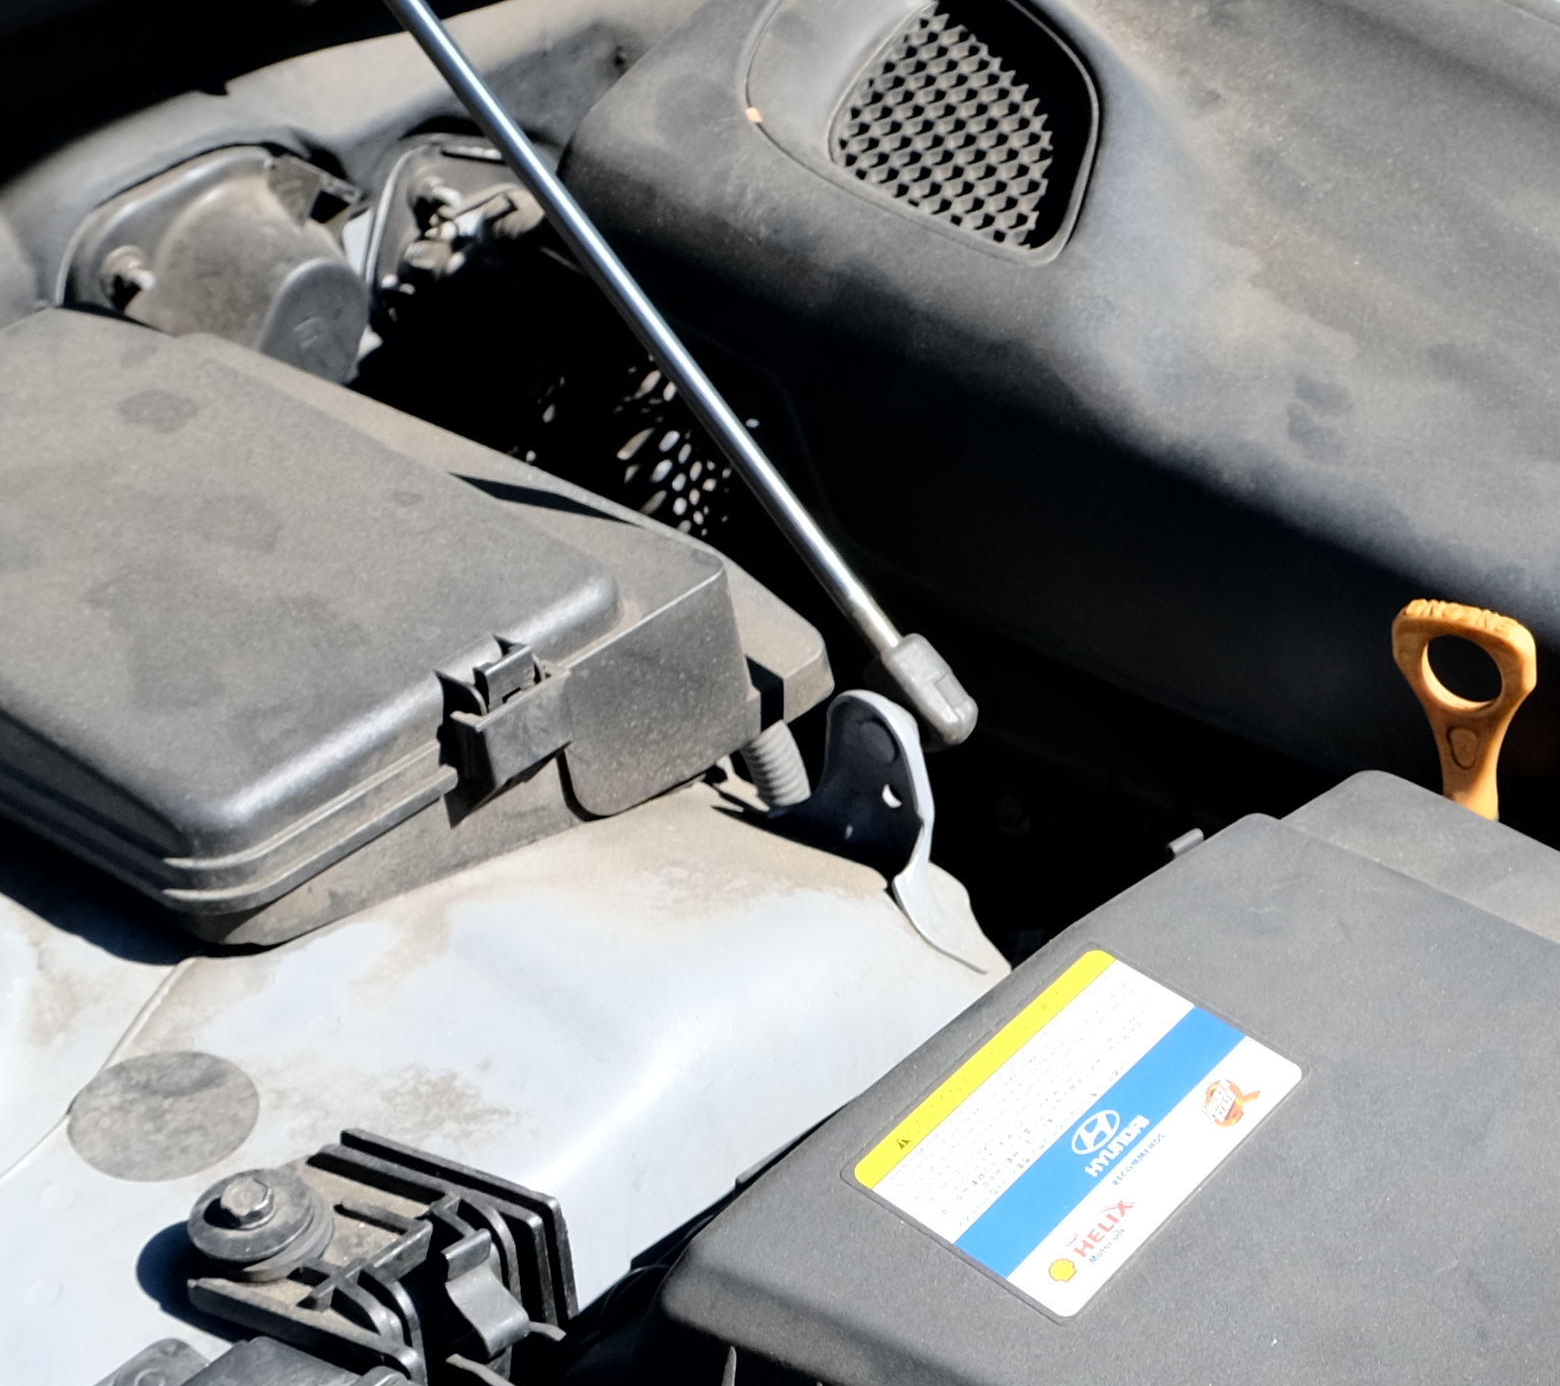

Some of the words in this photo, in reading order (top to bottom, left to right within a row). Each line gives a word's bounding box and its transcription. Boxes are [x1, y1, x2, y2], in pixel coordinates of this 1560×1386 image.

[1084, 1115, 1150, 1178] HYUNDAI
[1111, 1133, 1167, 1186] RECOMMENDS
[1075, 1200, 1135, 1258] HELIX
